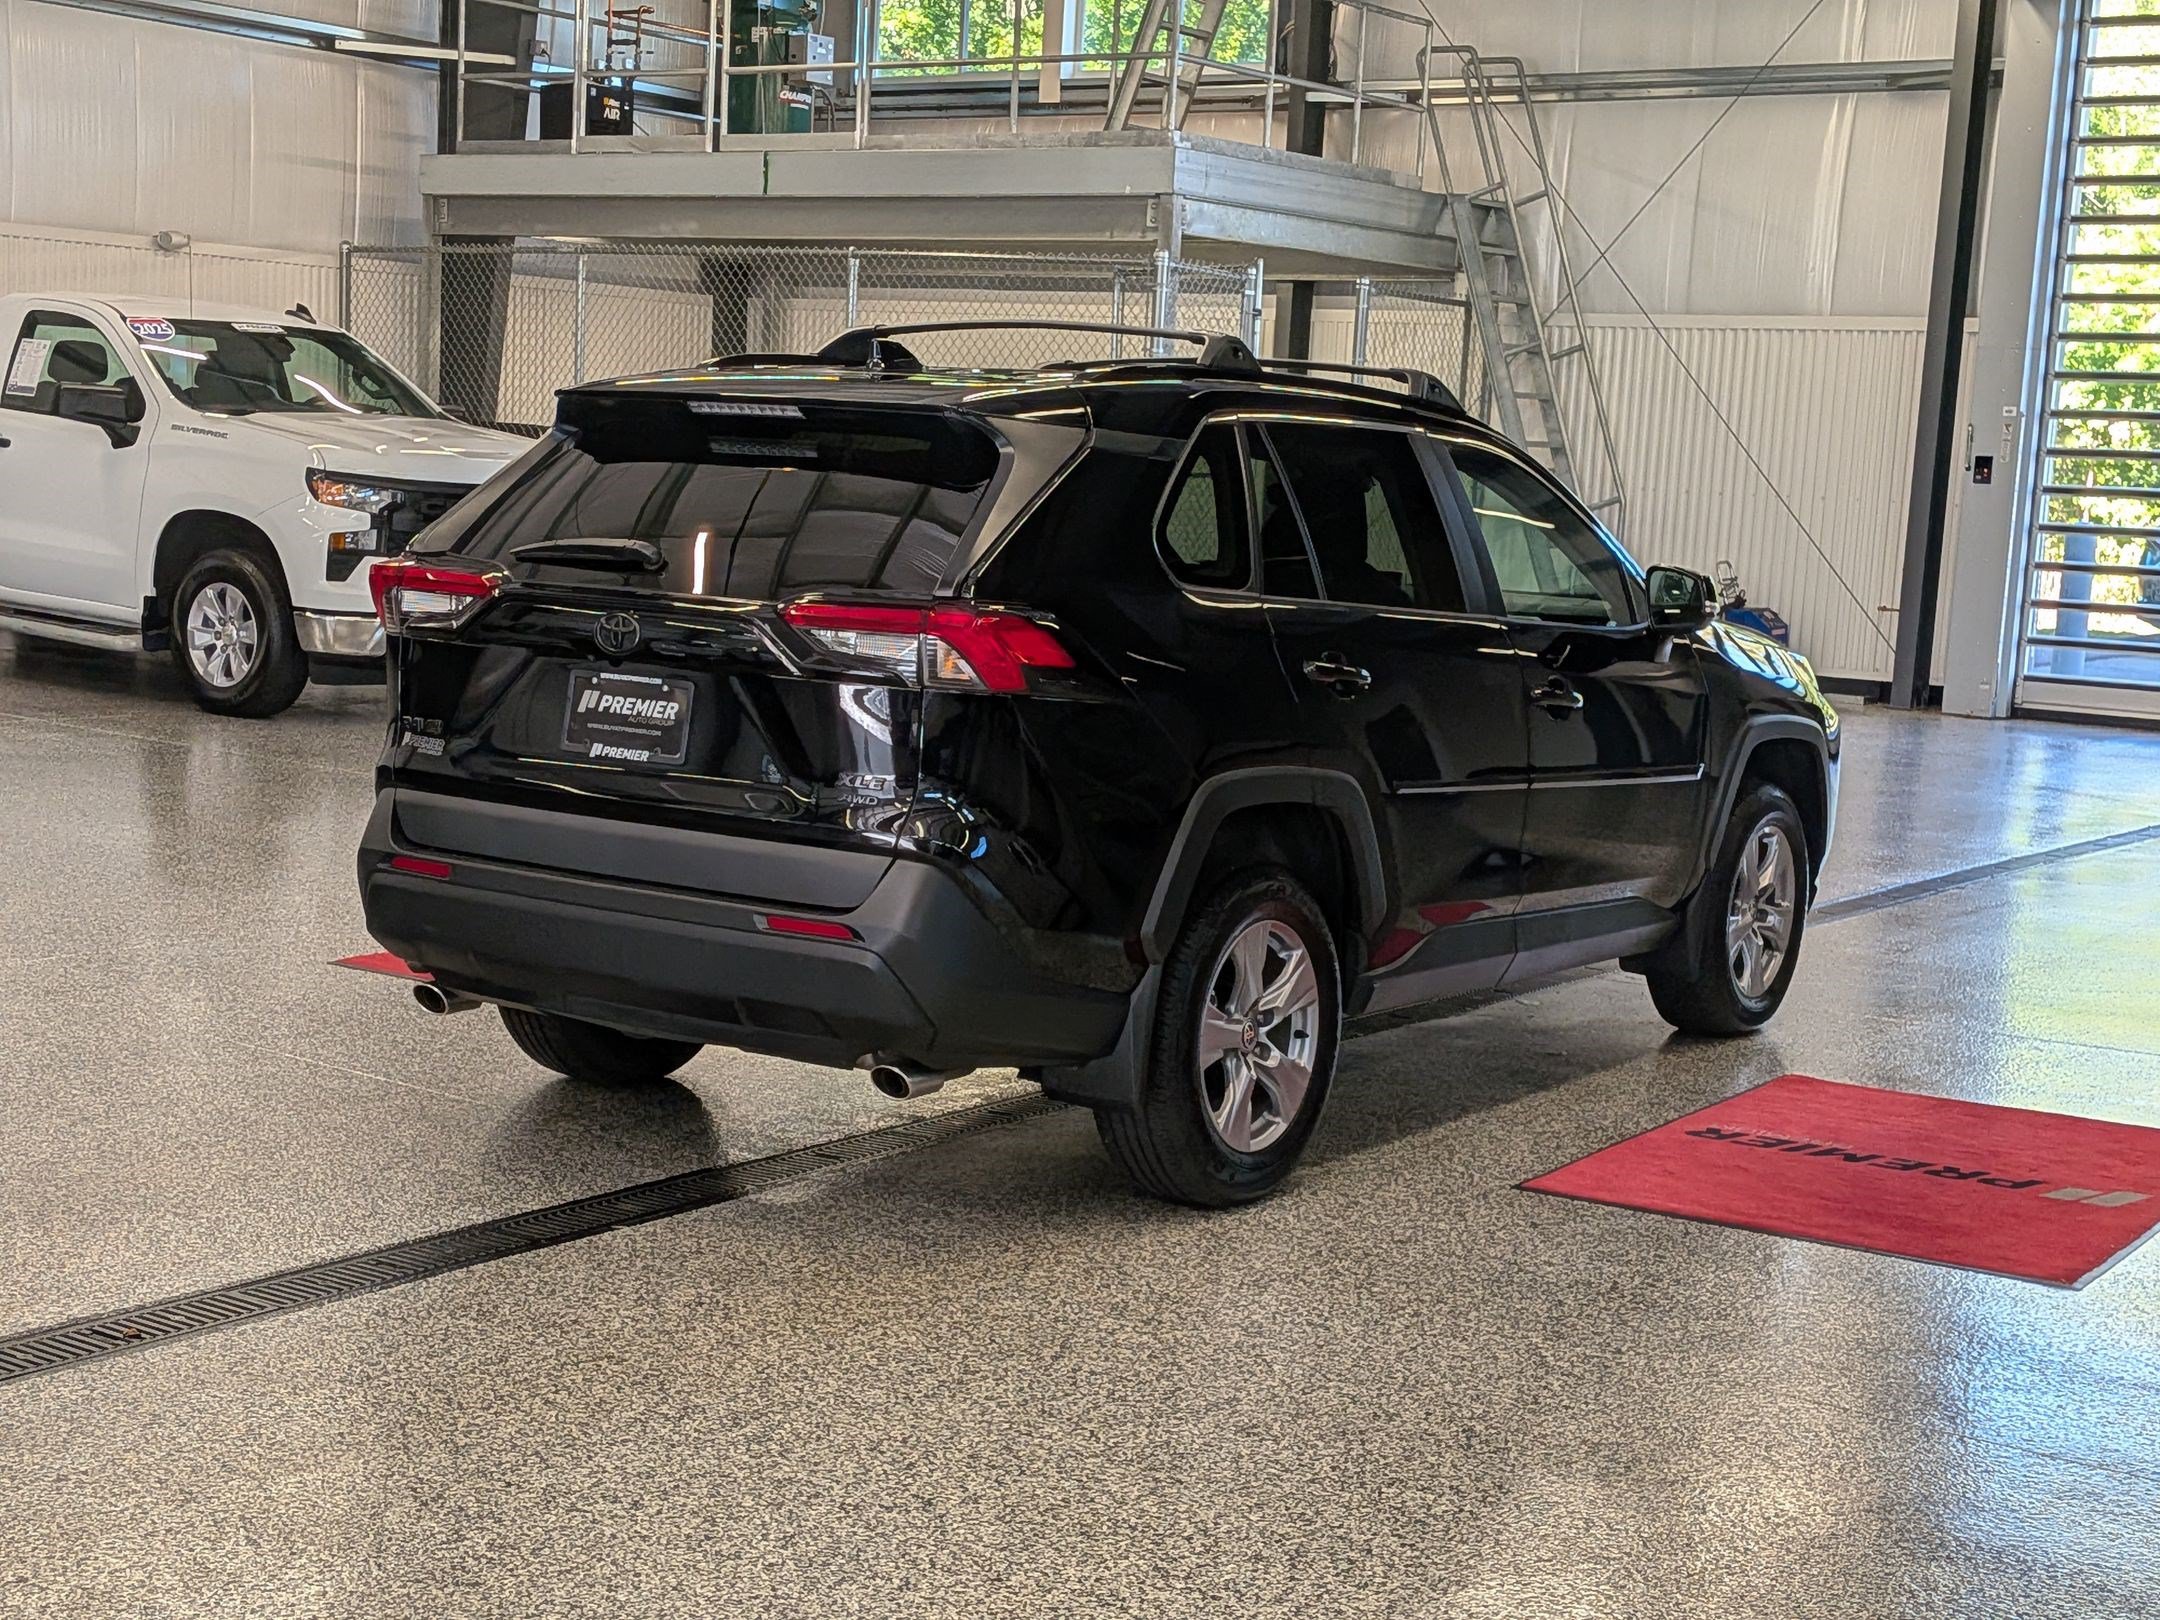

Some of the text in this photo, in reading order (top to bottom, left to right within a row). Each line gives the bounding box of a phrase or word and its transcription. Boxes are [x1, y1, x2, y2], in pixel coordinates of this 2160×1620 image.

[603, 107, 621, 120] AIR
[137, 323, 173, 335] 2025
[170, 424, 230, 439] SILVERADO
[598, 694, 679, 720] PREMIER
[627, 716, 675, 727] AUTO GROUP
[409, 734, 446, 752] PREMIER
[601, 746, 650, 761] PREMIER
[835, 771, 887, 791] XLE
[837, 794, 879, 805] AWD
[1685, 1127, 2047, 1189] PREMIER
